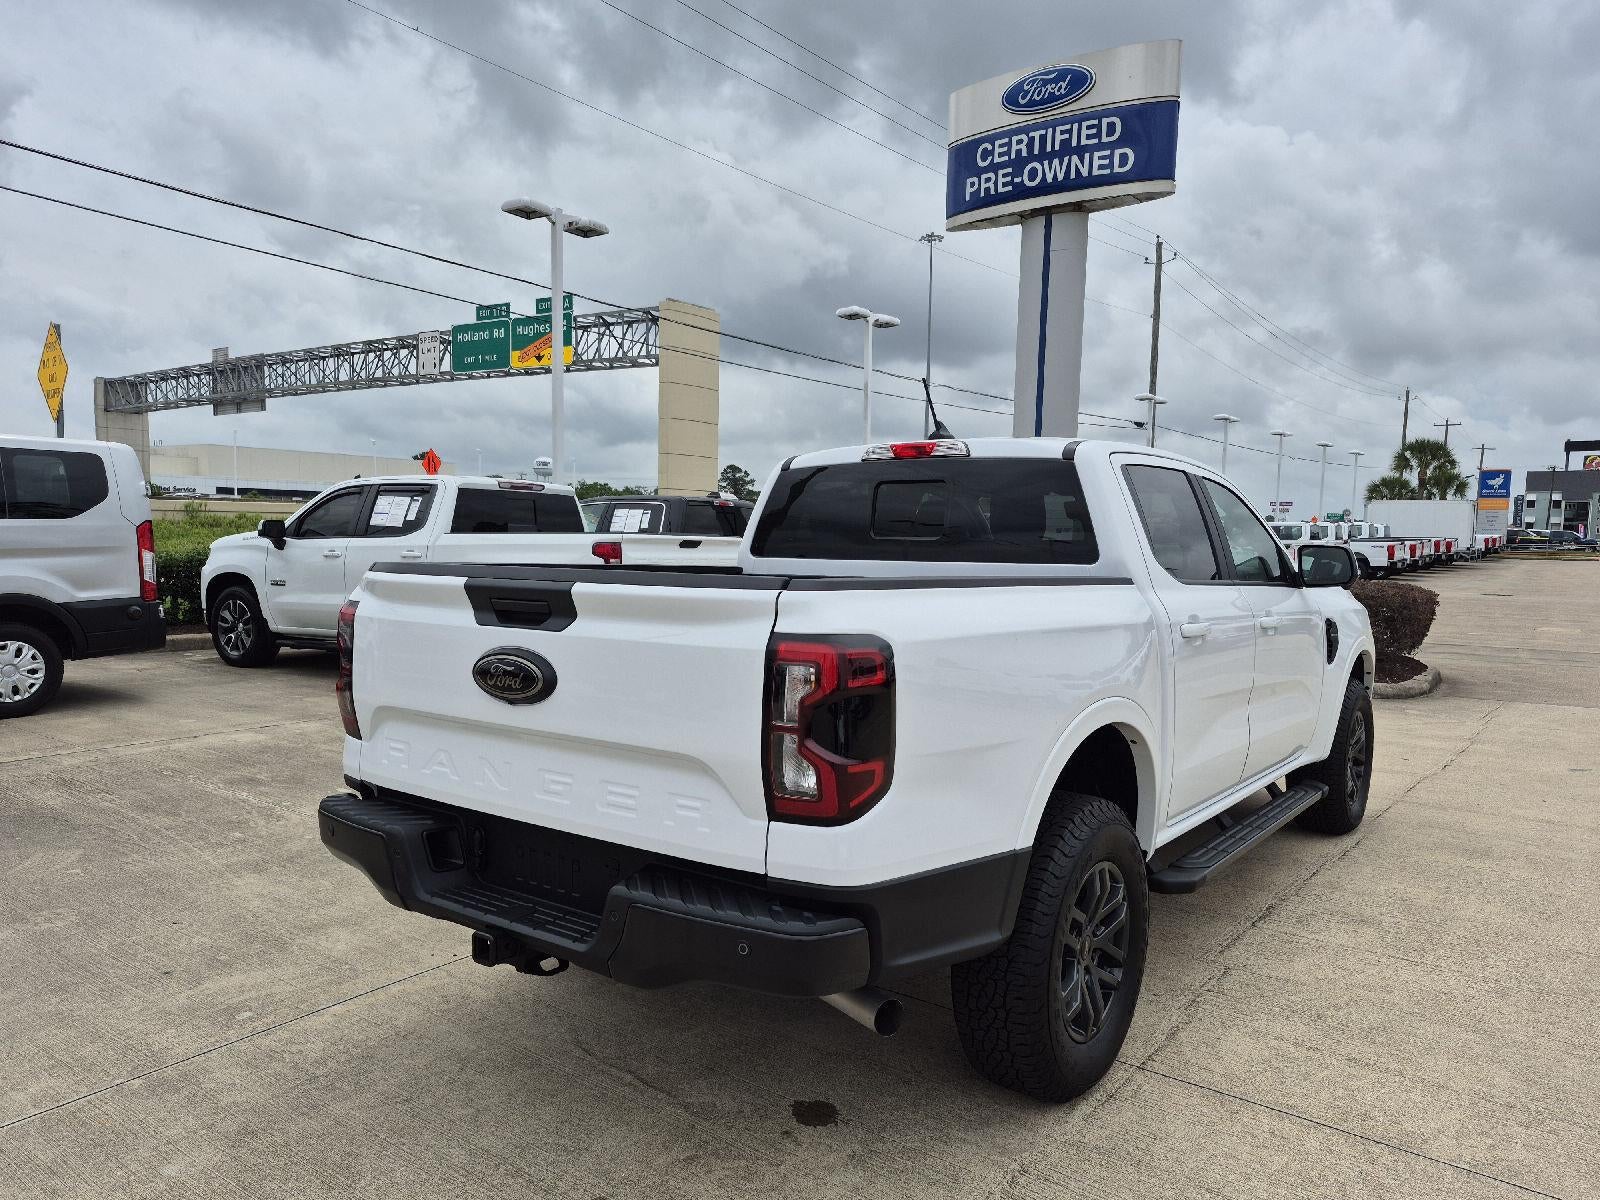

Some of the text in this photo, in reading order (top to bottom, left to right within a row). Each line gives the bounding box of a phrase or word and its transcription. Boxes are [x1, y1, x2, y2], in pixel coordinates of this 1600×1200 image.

[1017, 71, 1072, 105] Ford
[975, 116, 1123, 168] CERTIFIED
[965, 147, 1135, 202] PRE-OWNED
[538, 301, 551, 310] EXIT
[457, 327, 505, 343] Holland Rd
[516, 322, 551, 337] Hughes
[419, 335, 439, 344] SPEED
[464, 356, 475, 364] EXIT
[172, 485, 197, 493] Service
[485, 661, 524, 691] Ford
[381, 736, 712, 833] RANGER
